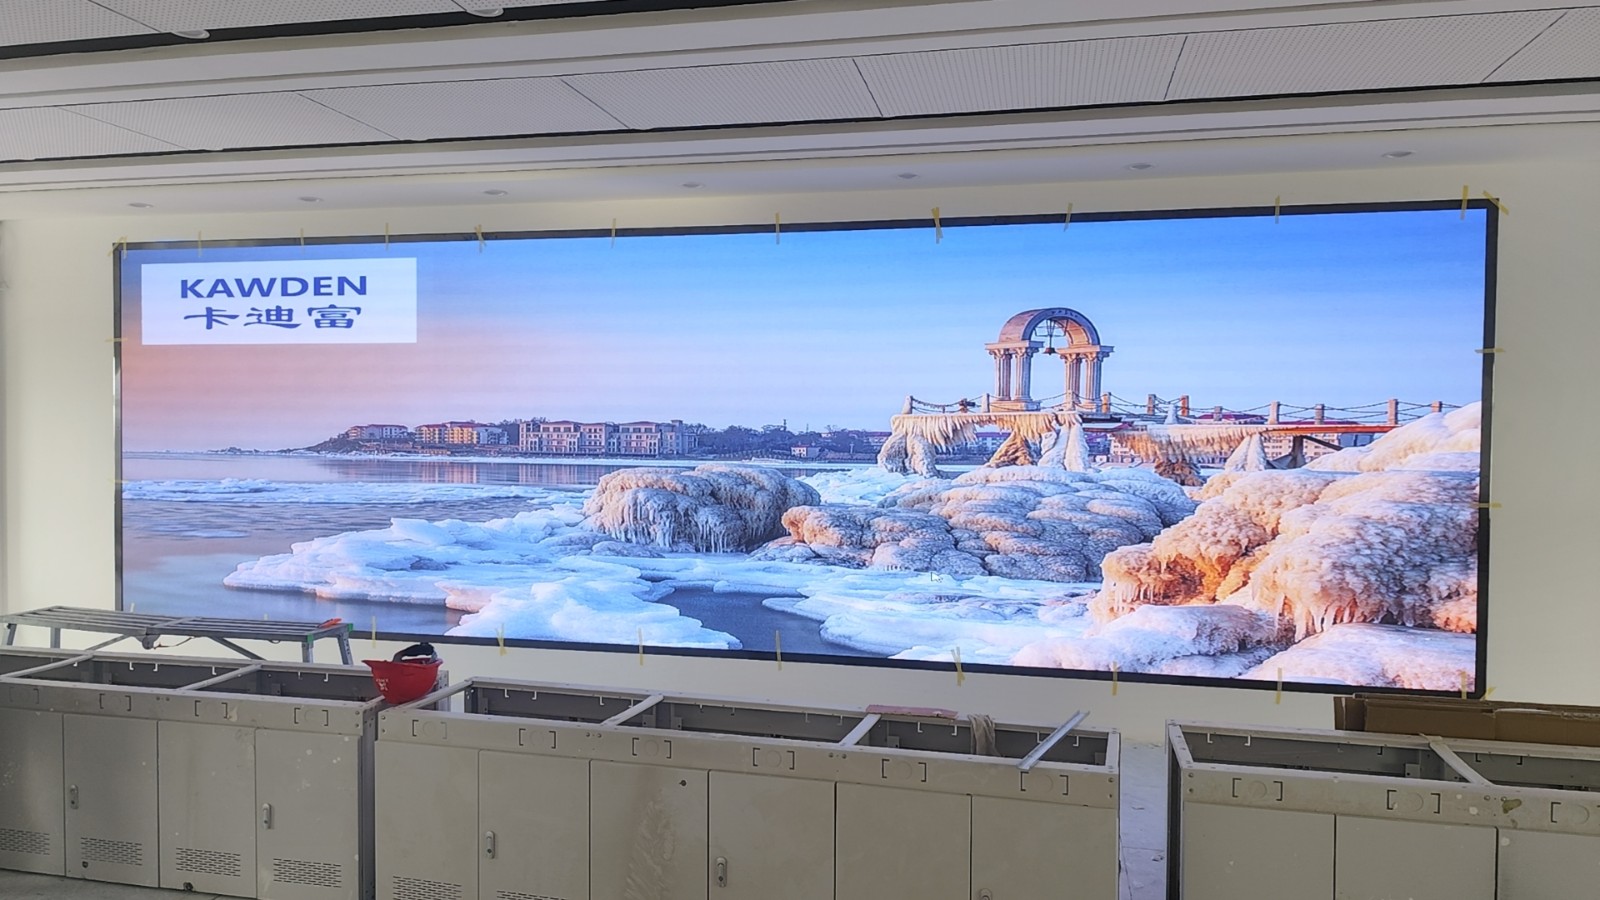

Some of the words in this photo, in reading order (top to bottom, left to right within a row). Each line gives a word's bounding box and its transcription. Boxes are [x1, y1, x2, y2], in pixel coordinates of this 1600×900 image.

[181, 276, 367, 298] KAWDEN
[183, 304, 362, 330] 卡迪富
